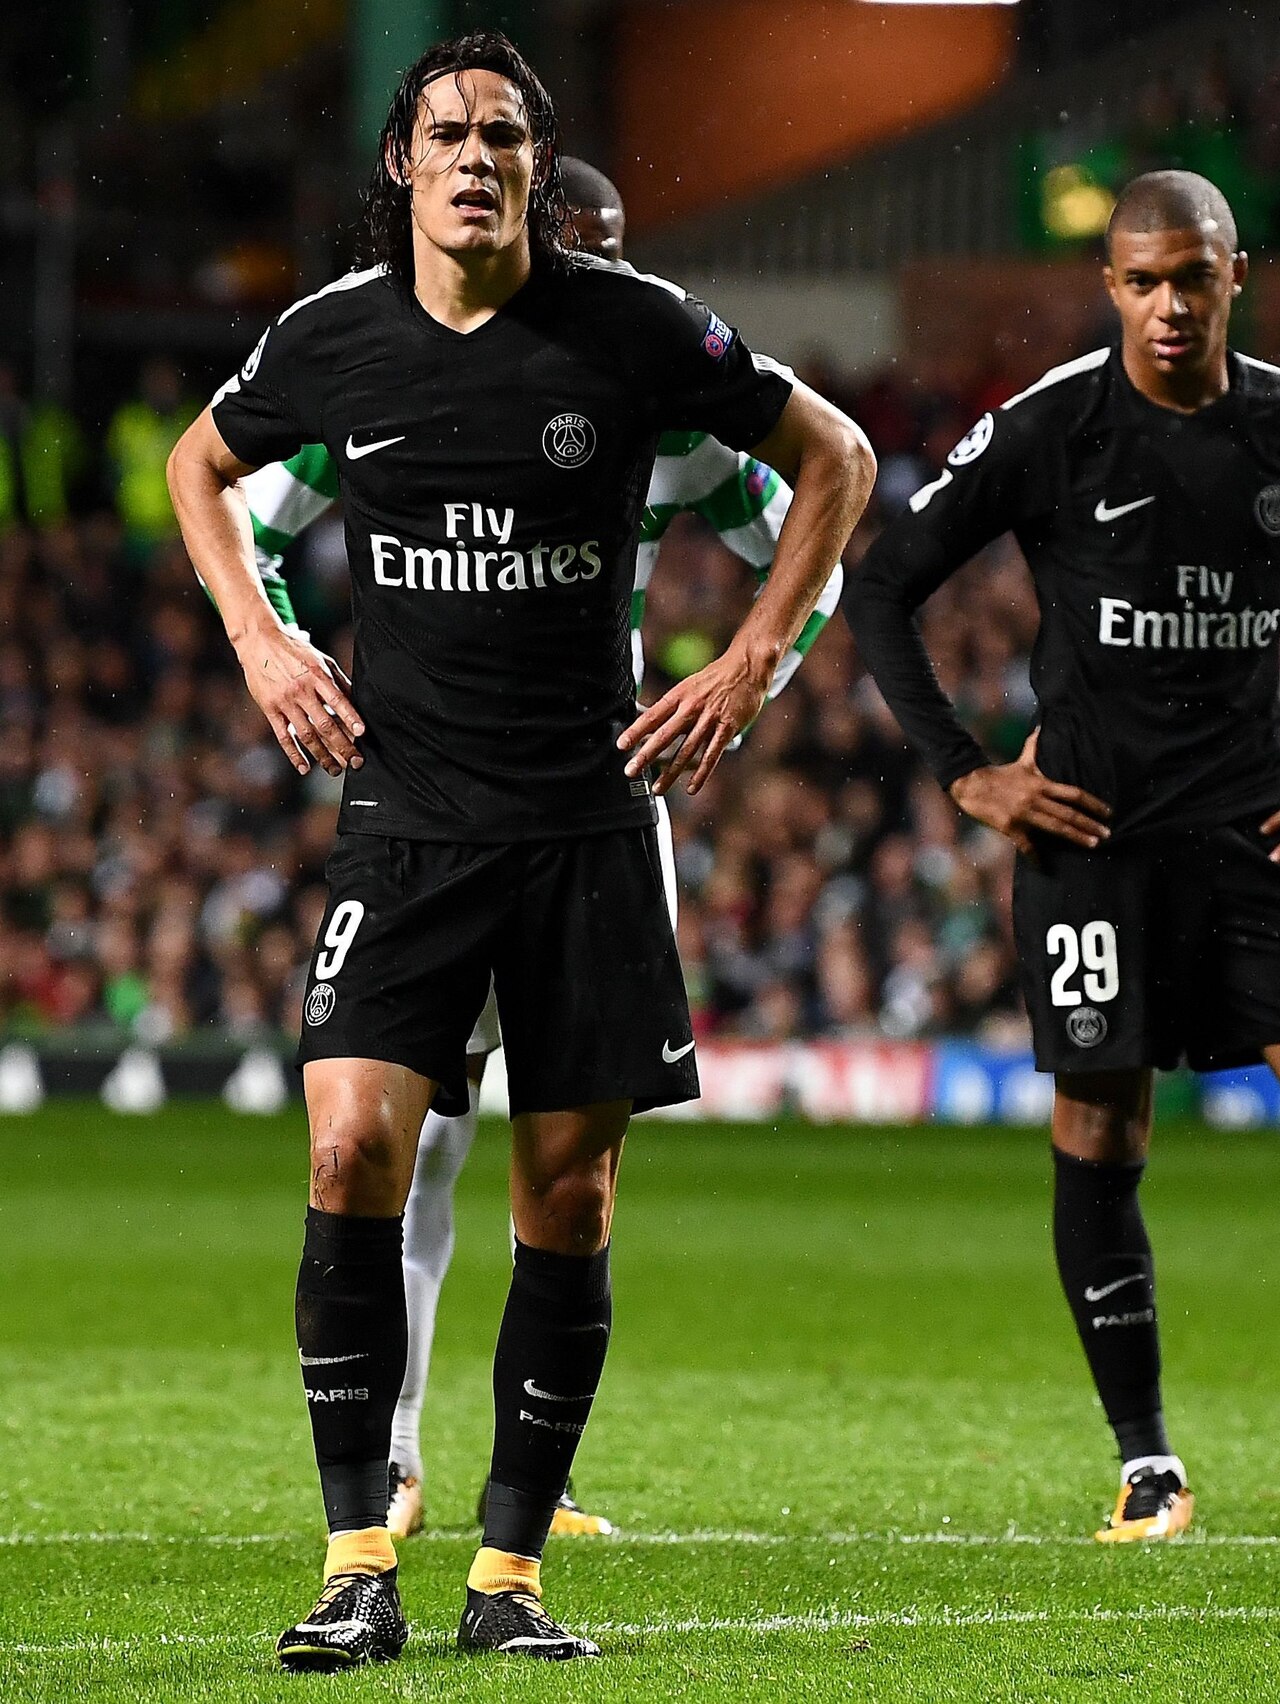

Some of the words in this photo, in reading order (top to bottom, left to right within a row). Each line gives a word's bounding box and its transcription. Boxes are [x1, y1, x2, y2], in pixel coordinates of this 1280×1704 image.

[550, 415, 586, 431] PARIS
[444, 502, 514, 545] Fly
[370, 534, 602, 592] Emirates
[1177, 565, 1234, 605] Fly
[315, 900, 365, 980] 9
[1046, 920, 1120, 1007] 29
[305, 1387, 369, 1402] PARIS
